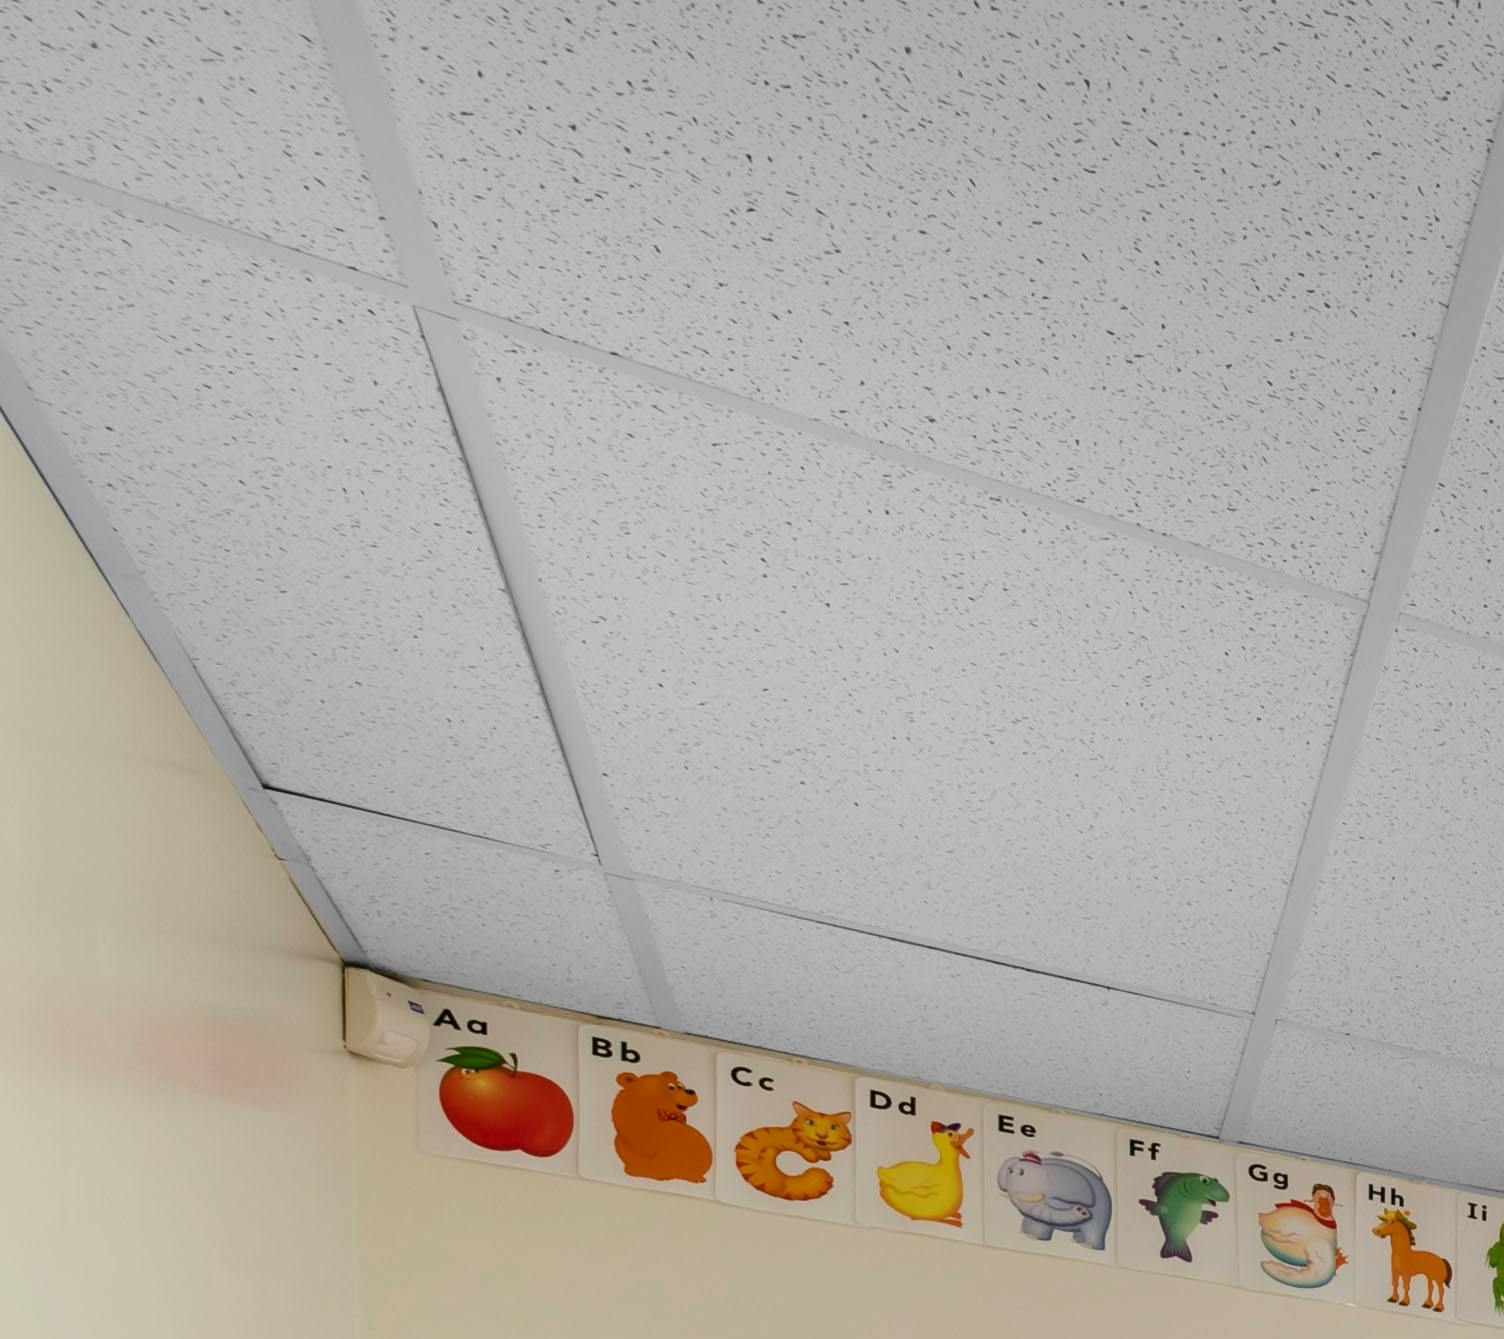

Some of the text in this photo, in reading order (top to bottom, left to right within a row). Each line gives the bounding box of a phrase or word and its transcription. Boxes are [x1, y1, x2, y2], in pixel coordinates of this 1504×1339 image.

[433, 1008, 490, 1036] Aa
[589, 1036, 644, 1066] Bb
[730, 1067, 776, 1092] Cc
[868, 1090, 918, 1118] Dd
[997, 1114, 1037, 1140] Ee
[1128, 1138, 1160, 1163] Ff
[1248, 1163, 1289, 1190] Gg
[1368, 1185, 1405, 1208] Hh
[1467, 1203, 1488, 1222] Ii
